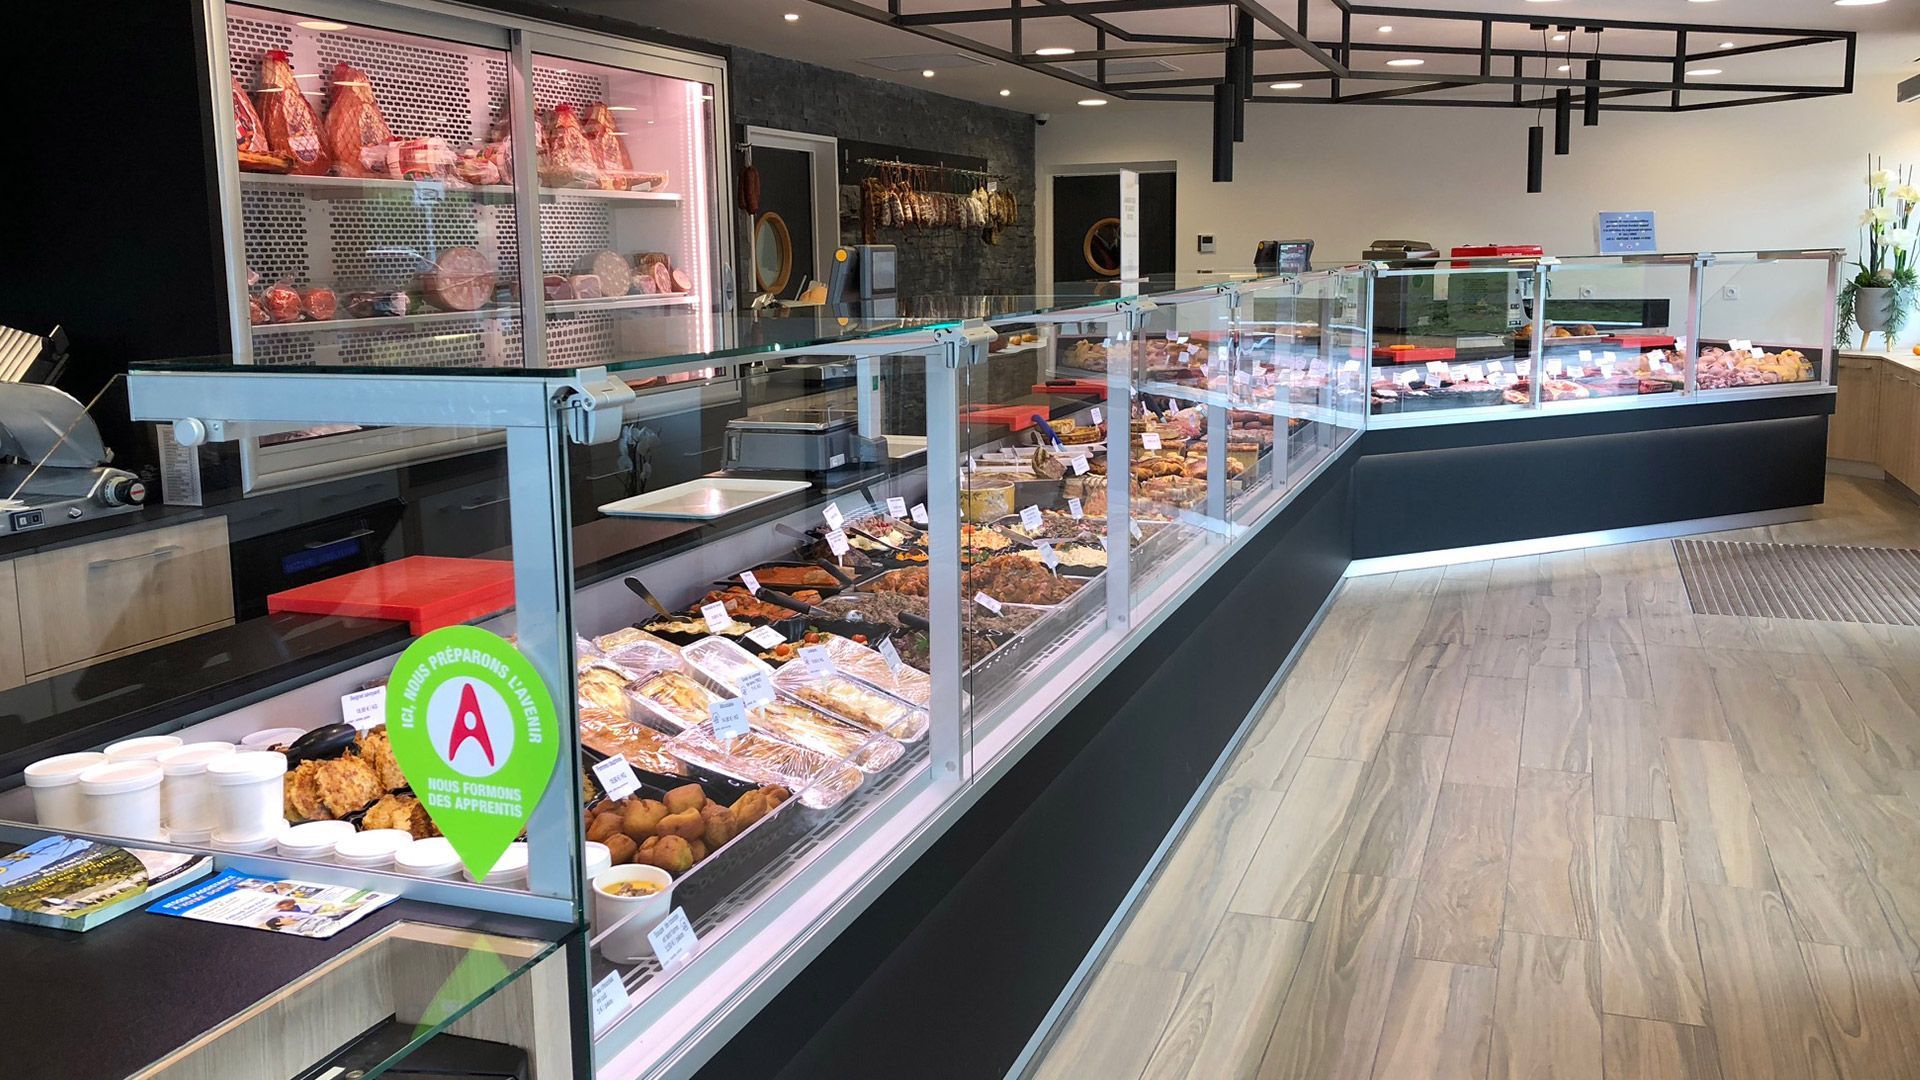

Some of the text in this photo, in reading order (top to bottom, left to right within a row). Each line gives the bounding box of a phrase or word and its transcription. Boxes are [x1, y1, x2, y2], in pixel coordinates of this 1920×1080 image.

[401, 645, 542, 743] ICI, NOUS PRÉPARONS L'AVENIR
[427, 777, 522, 802] NOUS FORMONS
[428, 793, 522, 818] DES APPRENTIS
